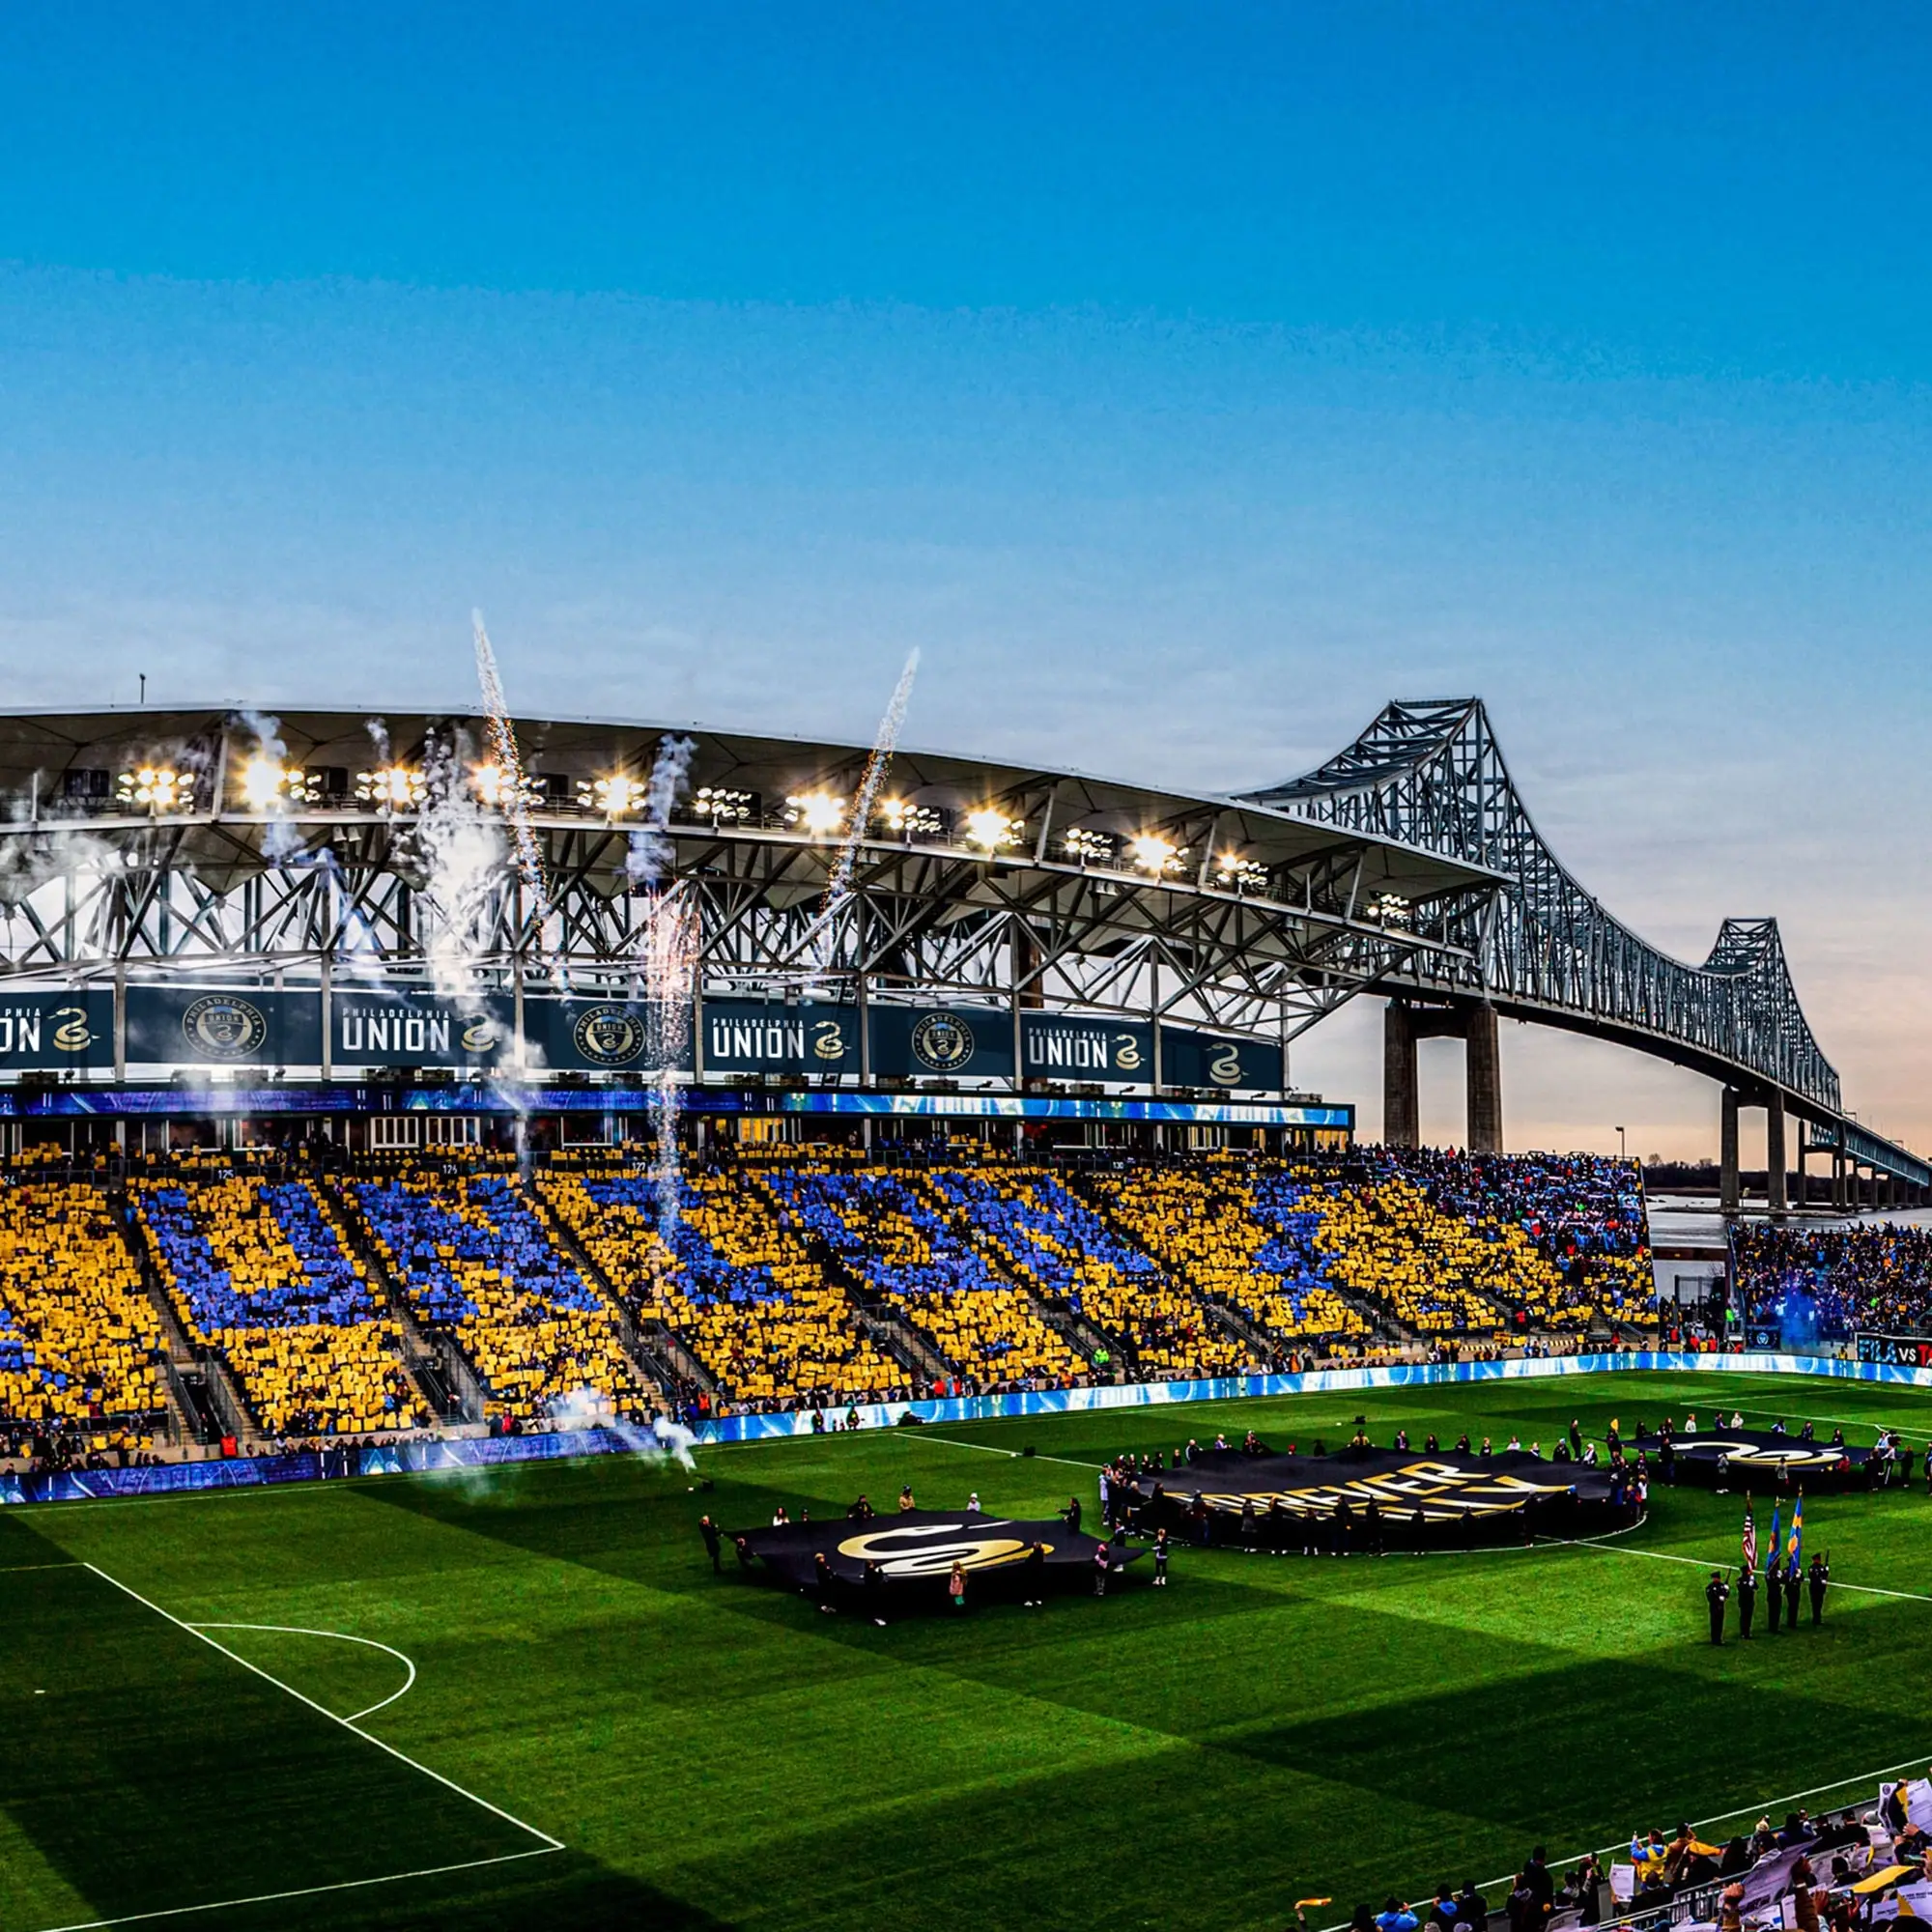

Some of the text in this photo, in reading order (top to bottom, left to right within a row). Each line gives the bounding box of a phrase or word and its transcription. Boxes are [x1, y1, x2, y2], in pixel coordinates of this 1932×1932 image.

[186, 997, 262, 1026] PHILADELPHIA
[342, 1008, 449, 1019] PHILADELPHIA
[713, 1017, 804, 1029] PHILADELPHIA
[343, 1017, 449, 1051] UNION
[713, 1027, 805, 1059] UNION
[1029, 1027, 1107, 1040] PHILADELPHIA
[1029, 1036, 1108, 1068] UNION
